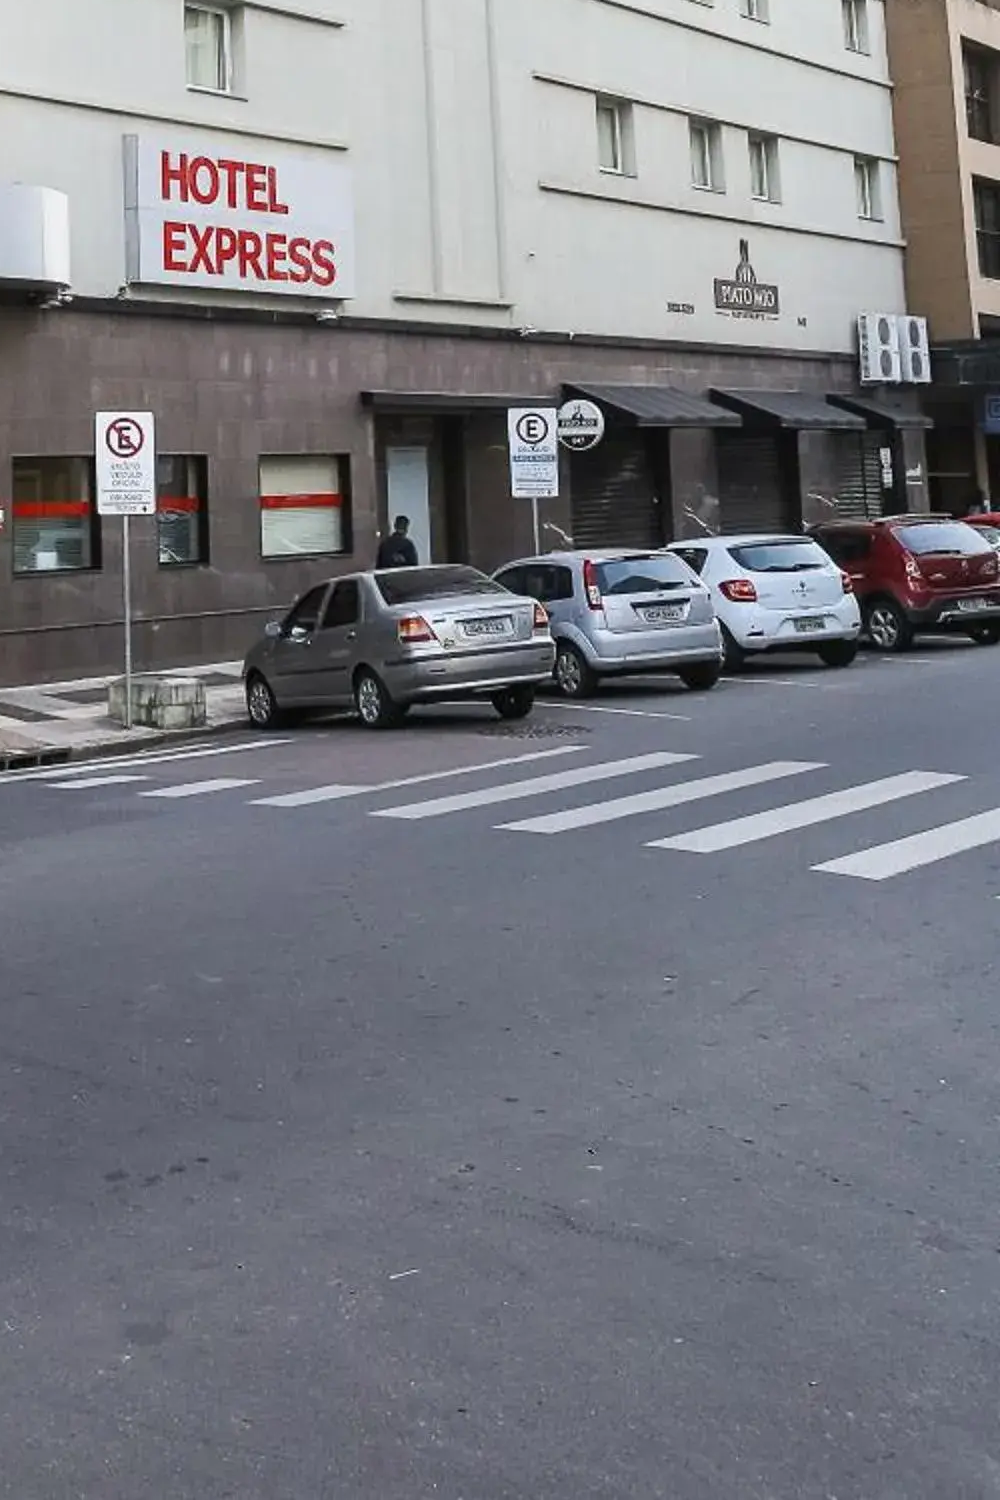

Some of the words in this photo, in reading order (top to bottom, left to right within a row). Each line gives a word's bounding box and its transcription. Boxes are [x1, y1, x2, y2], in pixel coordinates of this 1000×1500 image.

[162, 150, 289, 215] HOTEL
[163, 220, 337, 287] EXPRESS
[526, 419, 538, 438] E
